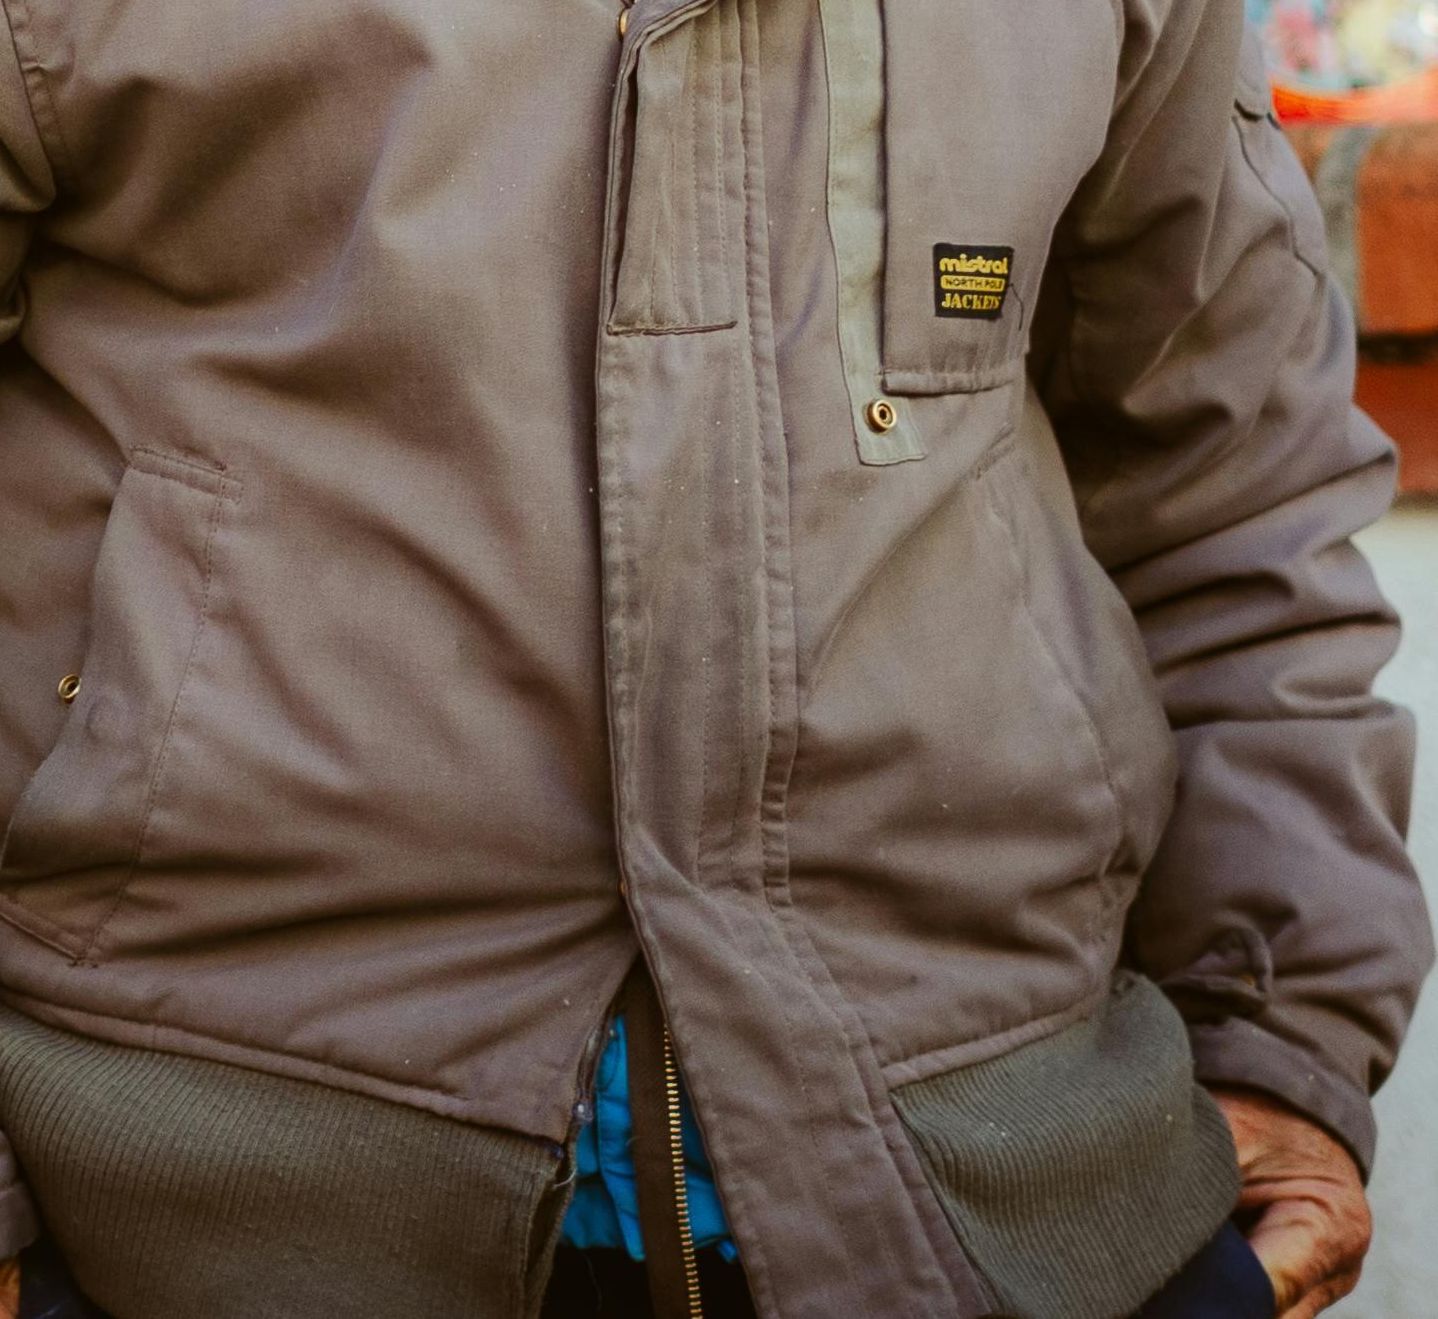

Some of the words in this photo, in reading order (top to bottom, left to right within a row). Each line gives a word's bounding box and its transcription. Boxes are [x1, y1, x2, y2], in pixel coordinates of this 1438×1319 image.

[939, 253, 1008, 275] mistral
[945, 277, 982, 288] NORTH
[984, 278, 1003, 290] POLE
